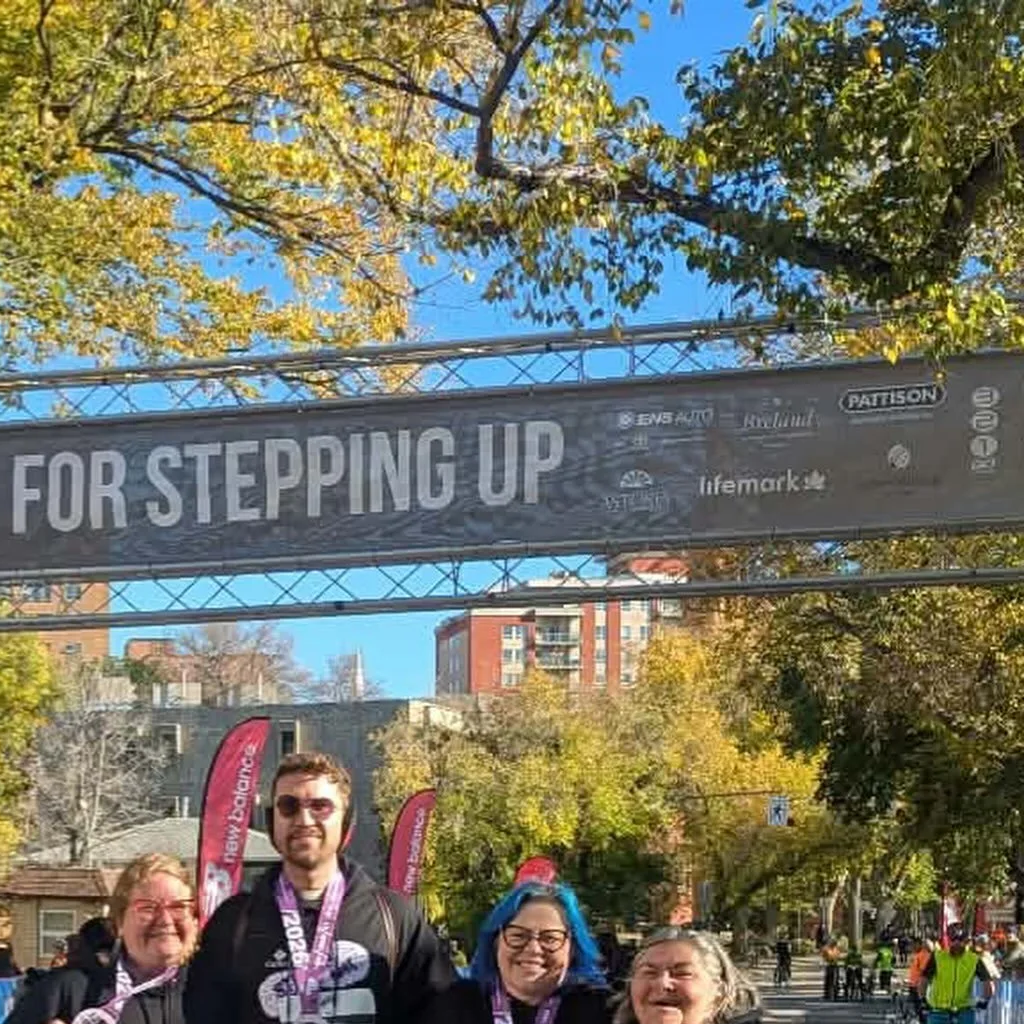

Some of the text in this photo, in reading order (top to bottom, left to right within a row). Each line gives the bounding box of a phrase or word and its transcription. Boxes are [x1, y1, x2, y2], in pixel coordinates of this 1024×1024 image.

[848, 387, 937, 409] PATTISON
[12, 450, 127, 534] FOR
[145, 426, 455, 528] STEPPING
[476, 420, 564, 507] UP
[699, 468, 800, 496] lifemark
[223, 744, 256, 864] new balance
